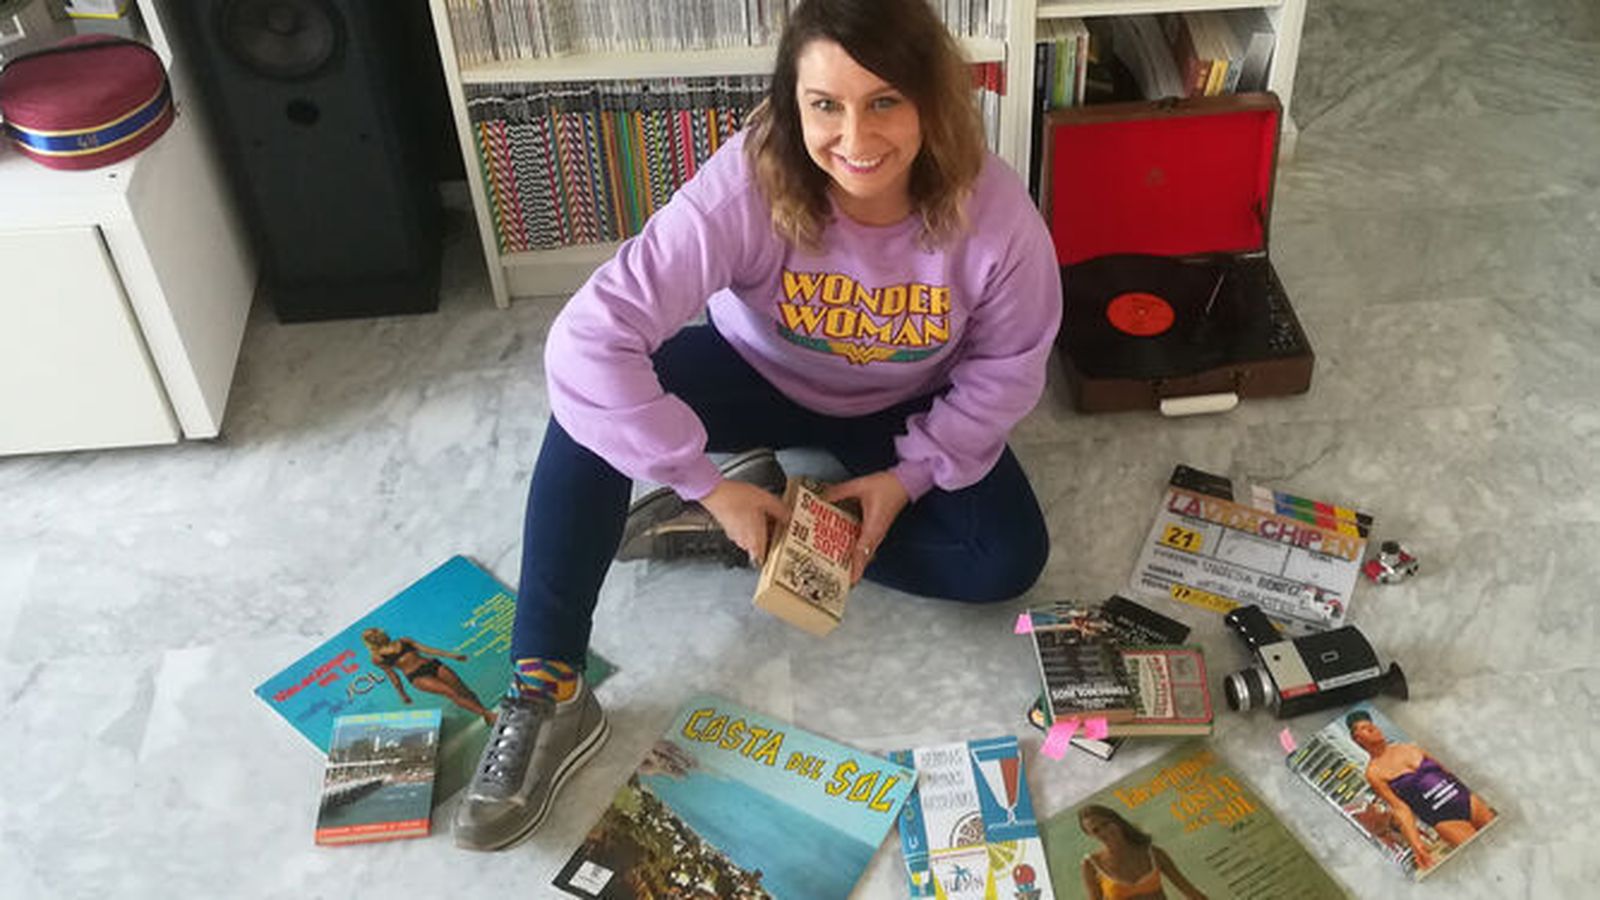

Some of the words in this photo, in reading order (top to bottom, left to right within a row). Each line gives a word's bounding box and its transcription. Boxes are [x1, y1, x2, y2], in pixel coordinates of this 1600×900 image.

[782, 267, 951, 316] WONDER
[778, 302, 949, 347] WOMAN
[682, 707, 785, 768] COSTA
[784, 751, 826, 781] DEL
[825, 759, 903, 814] SOL
